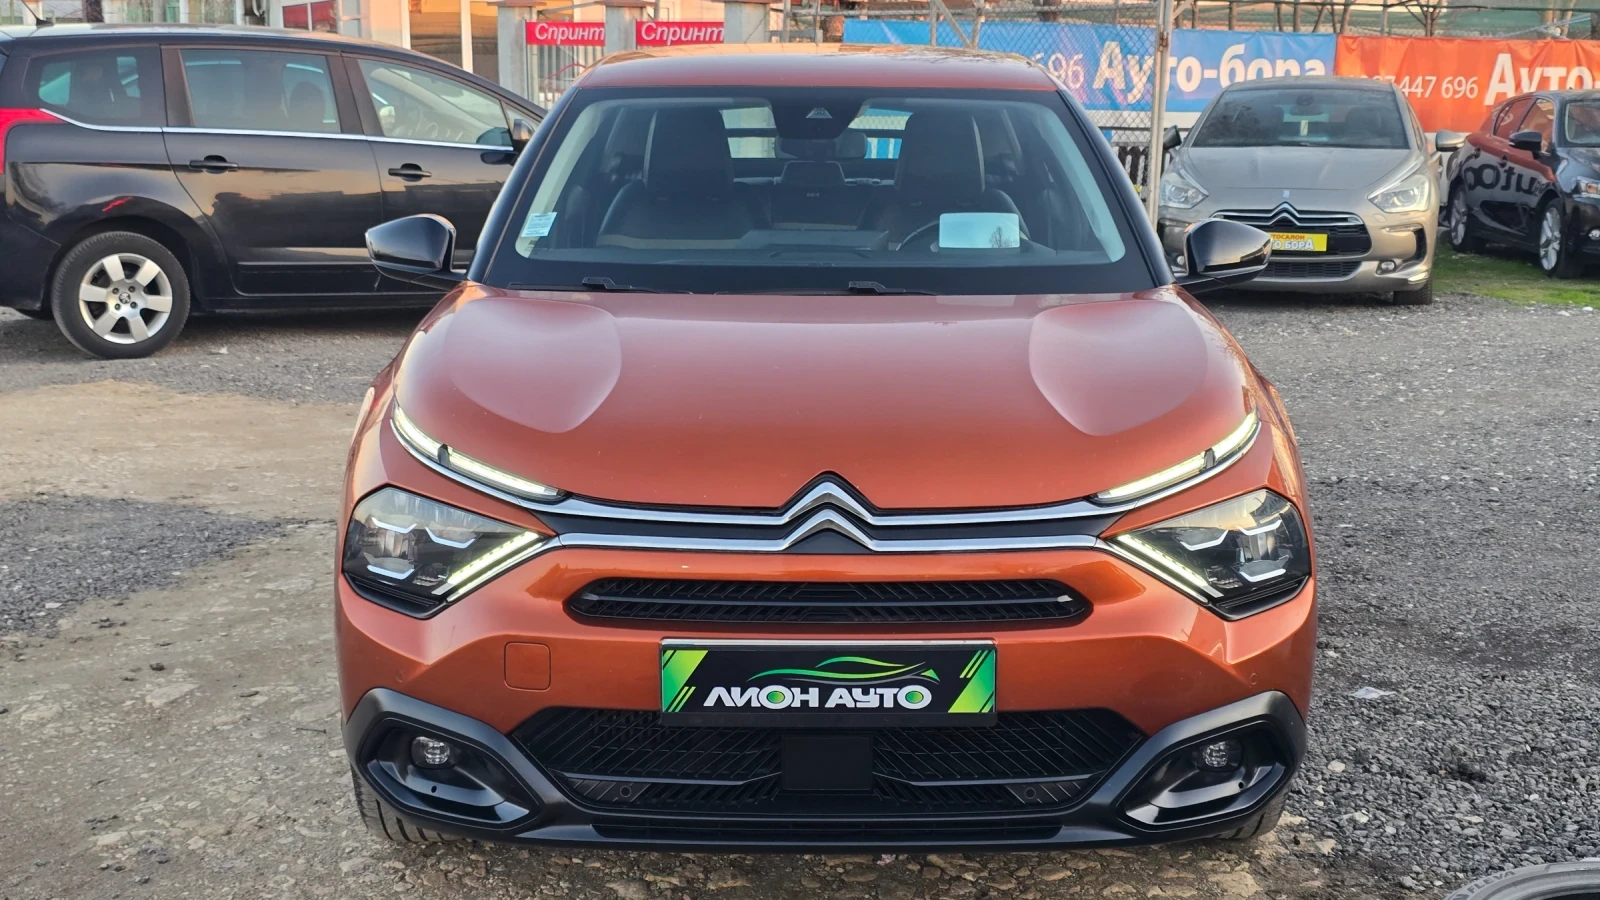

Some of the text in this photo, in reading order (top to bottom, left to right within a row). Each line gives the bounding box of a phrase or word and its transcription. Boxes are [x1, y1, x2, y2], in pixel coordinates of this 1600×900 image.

[535, 23, 604, 44] Спринт
[641, 22, 724, 45] Спринт
[1032, 52, 1083, 89] 96
[1441, 76, 1479, 98] 696
[1285, 239, 1315, 250] БОРА
[703, 684, 932, 710] ЛИОН АУТО
